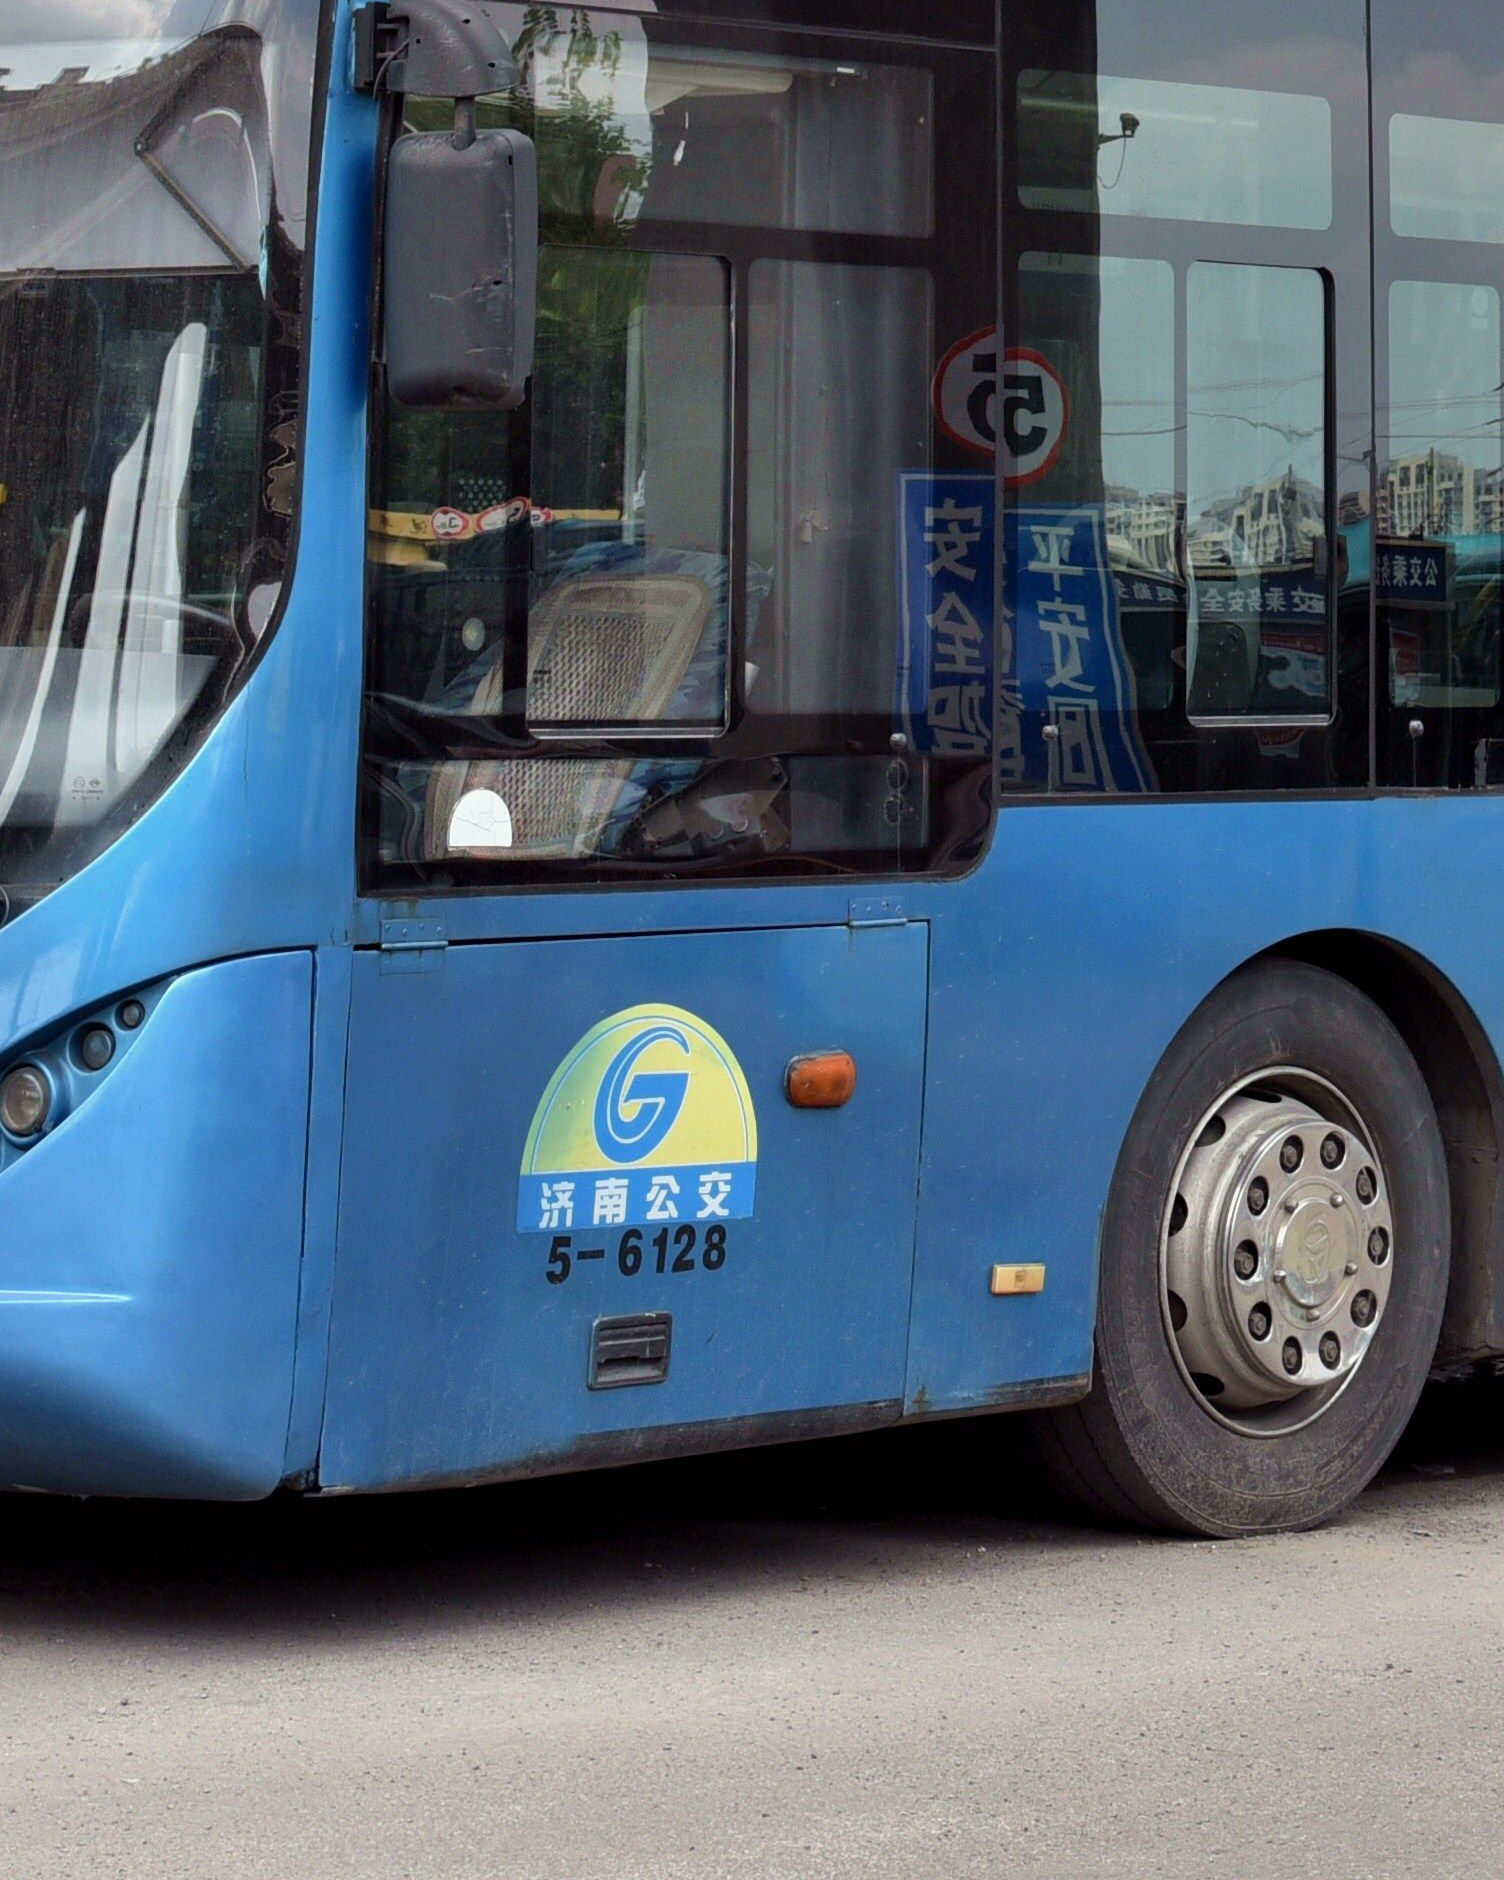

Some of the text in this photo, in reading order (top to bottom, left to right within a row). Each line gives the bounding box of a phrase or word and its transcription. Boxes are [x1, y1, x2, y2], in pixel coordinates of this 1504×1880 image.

[538, 1171, 733, 1229] 济南公交
[546, 1223, 727, 1284] 5-6128
